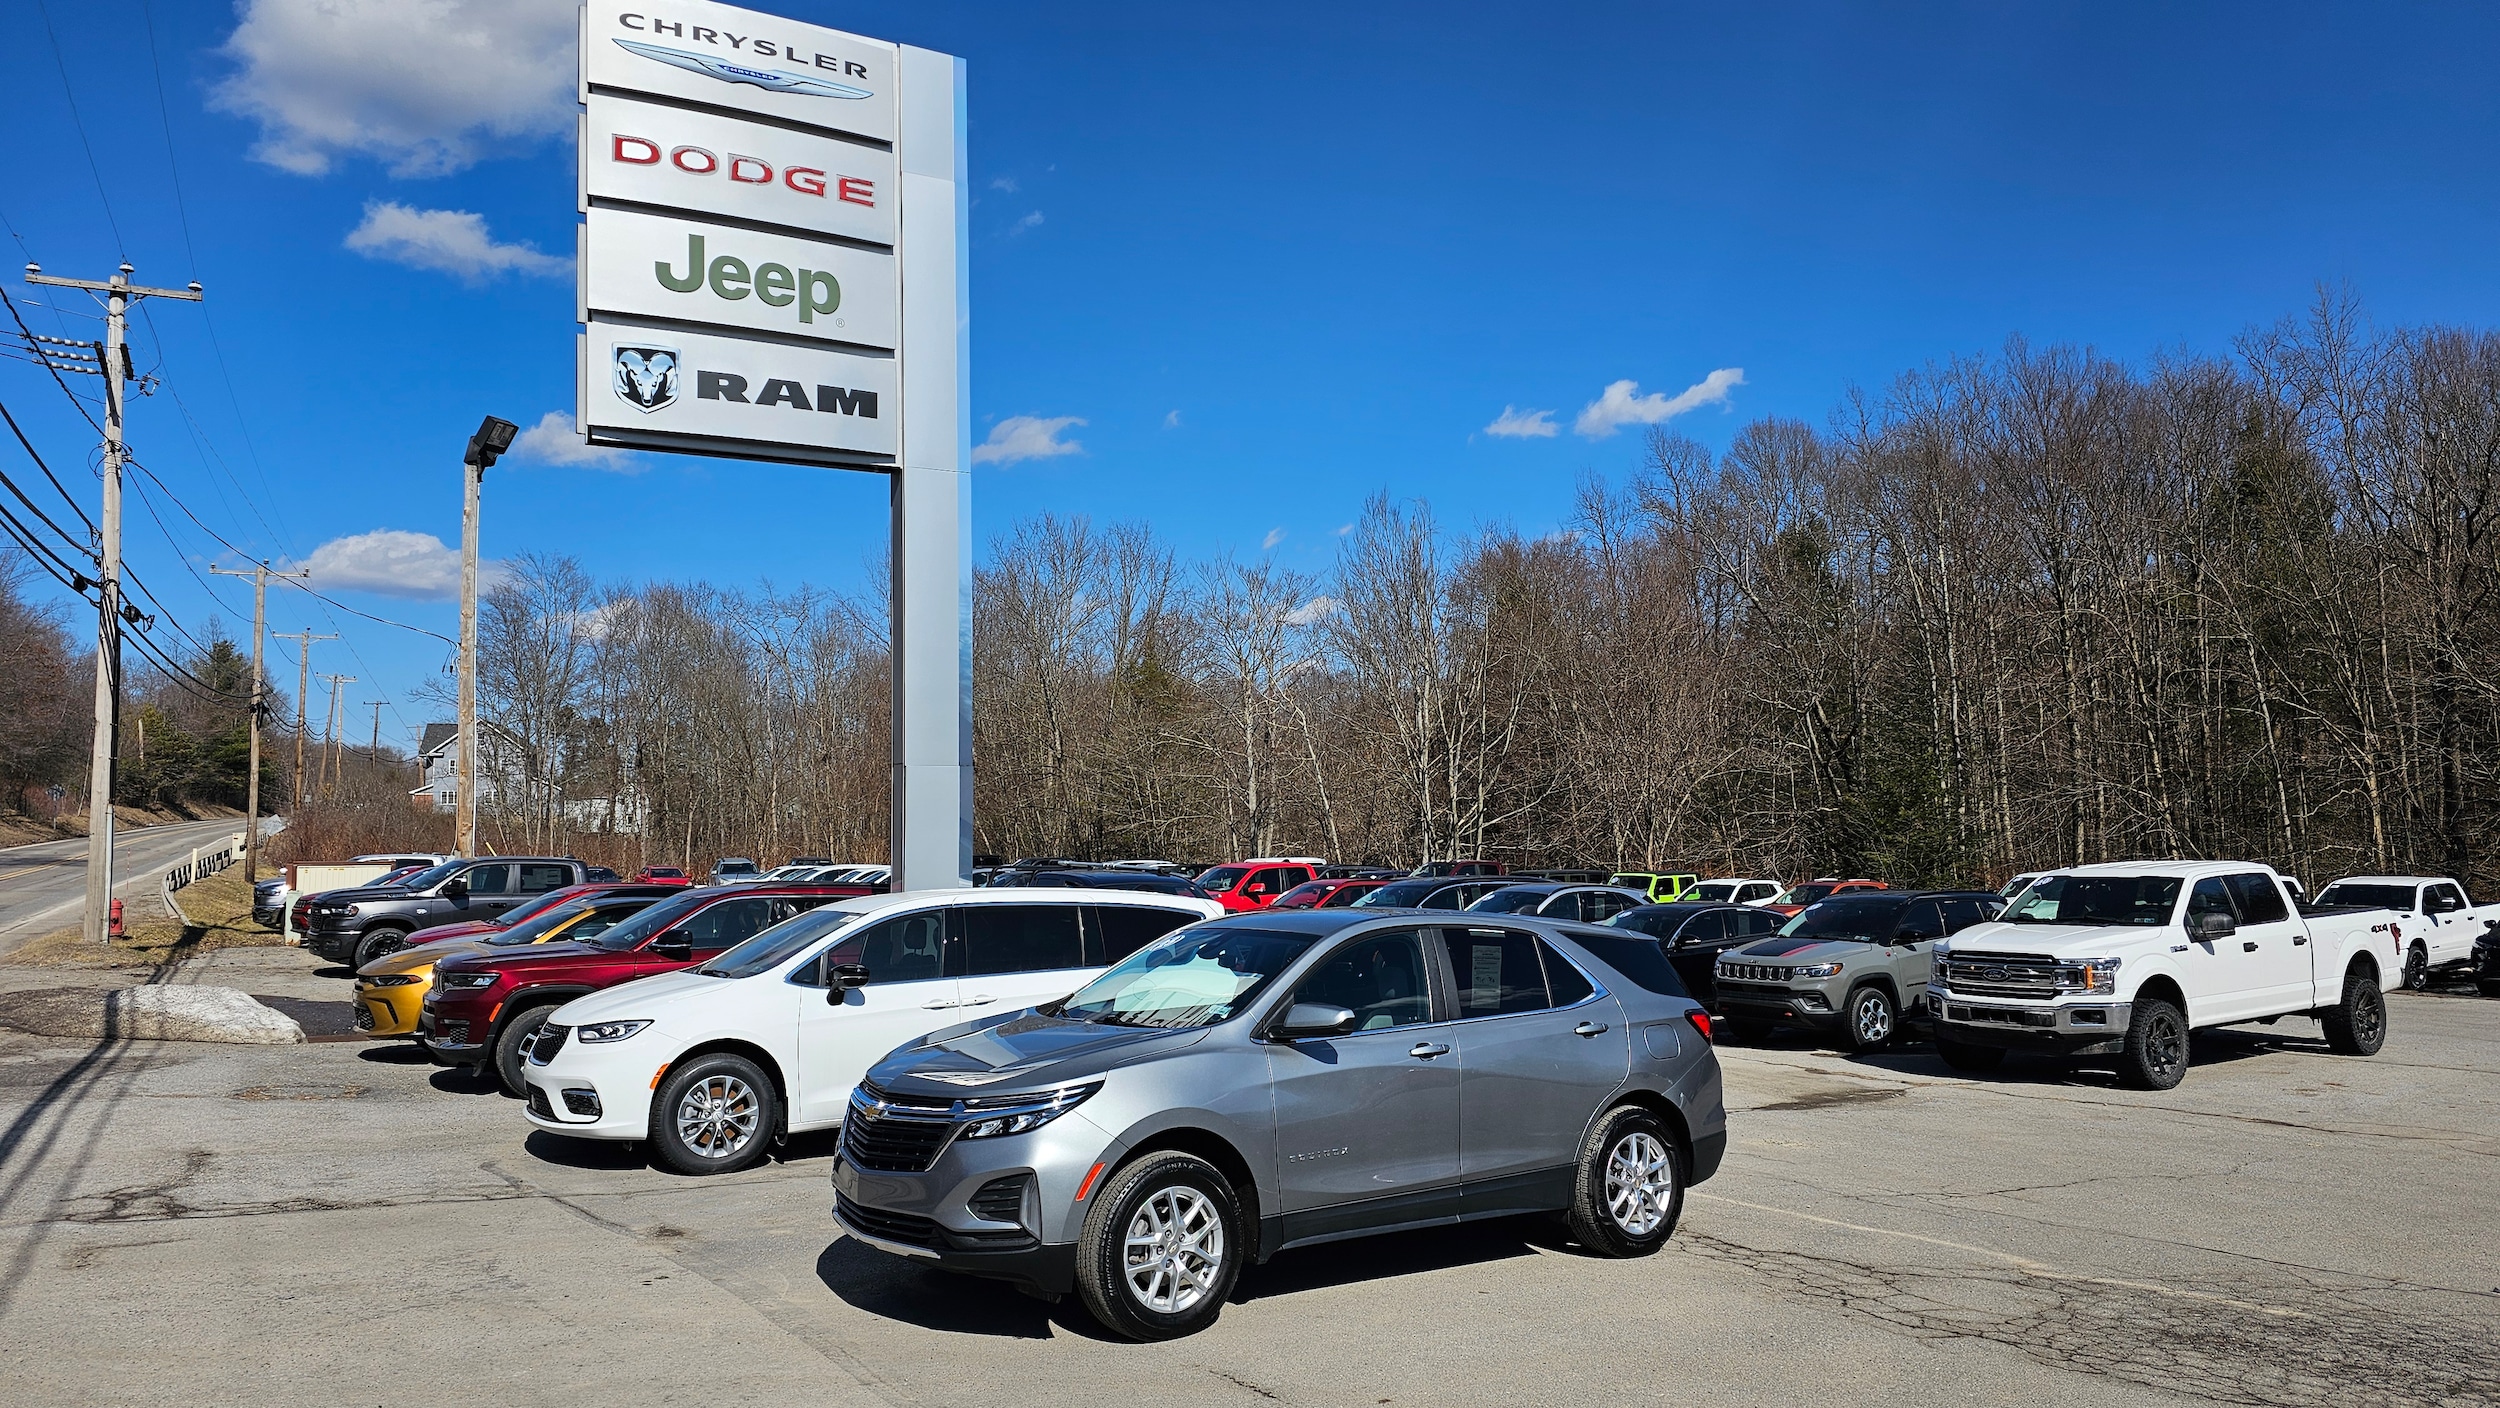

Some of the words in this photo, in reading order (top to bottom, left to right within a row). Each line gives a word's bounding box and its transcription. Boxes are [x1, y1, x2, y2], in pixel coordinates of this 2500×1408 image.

[618, 13, 868, 80] CHRYSLER
[722, 66, 775, 80] CHRYSLER
[611, 133, 876, 209] DODGE
[654, 233, 842, 325] Jeep
[697, 370, 878, 420] RAM
